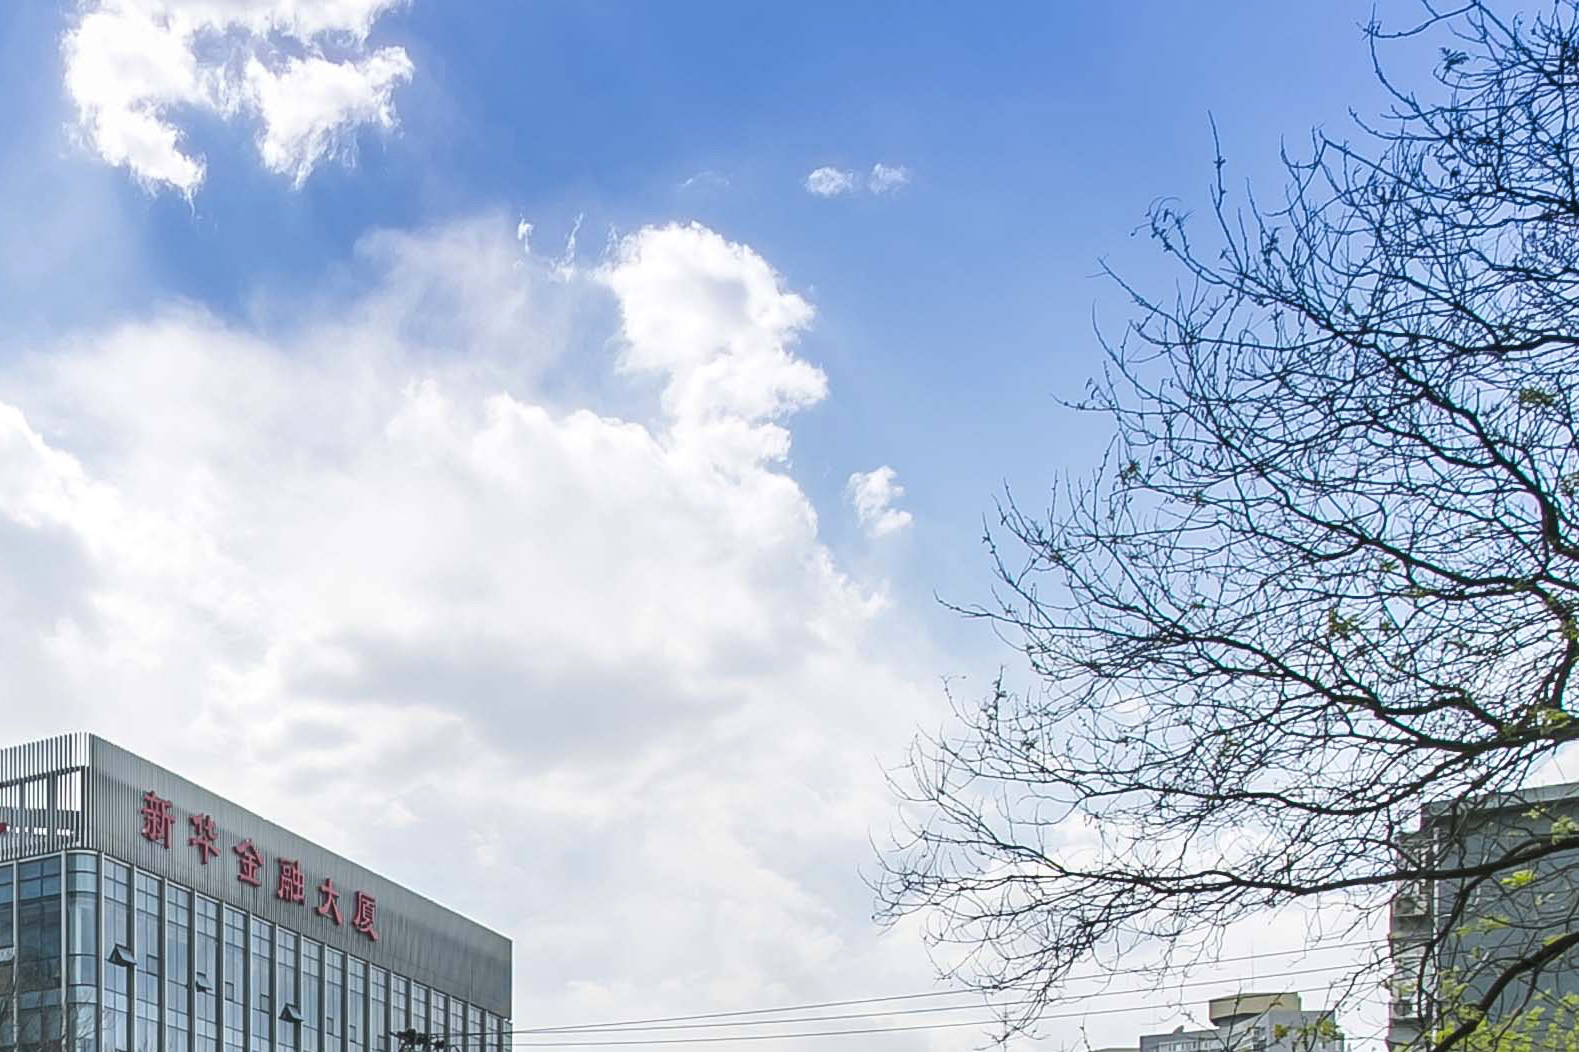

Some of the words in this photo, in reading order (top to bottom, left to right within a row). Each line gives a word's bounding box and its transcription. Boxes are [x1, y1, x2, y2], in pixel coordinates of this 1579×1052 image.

[141, 789, 378, 941] 新华金融大厦
